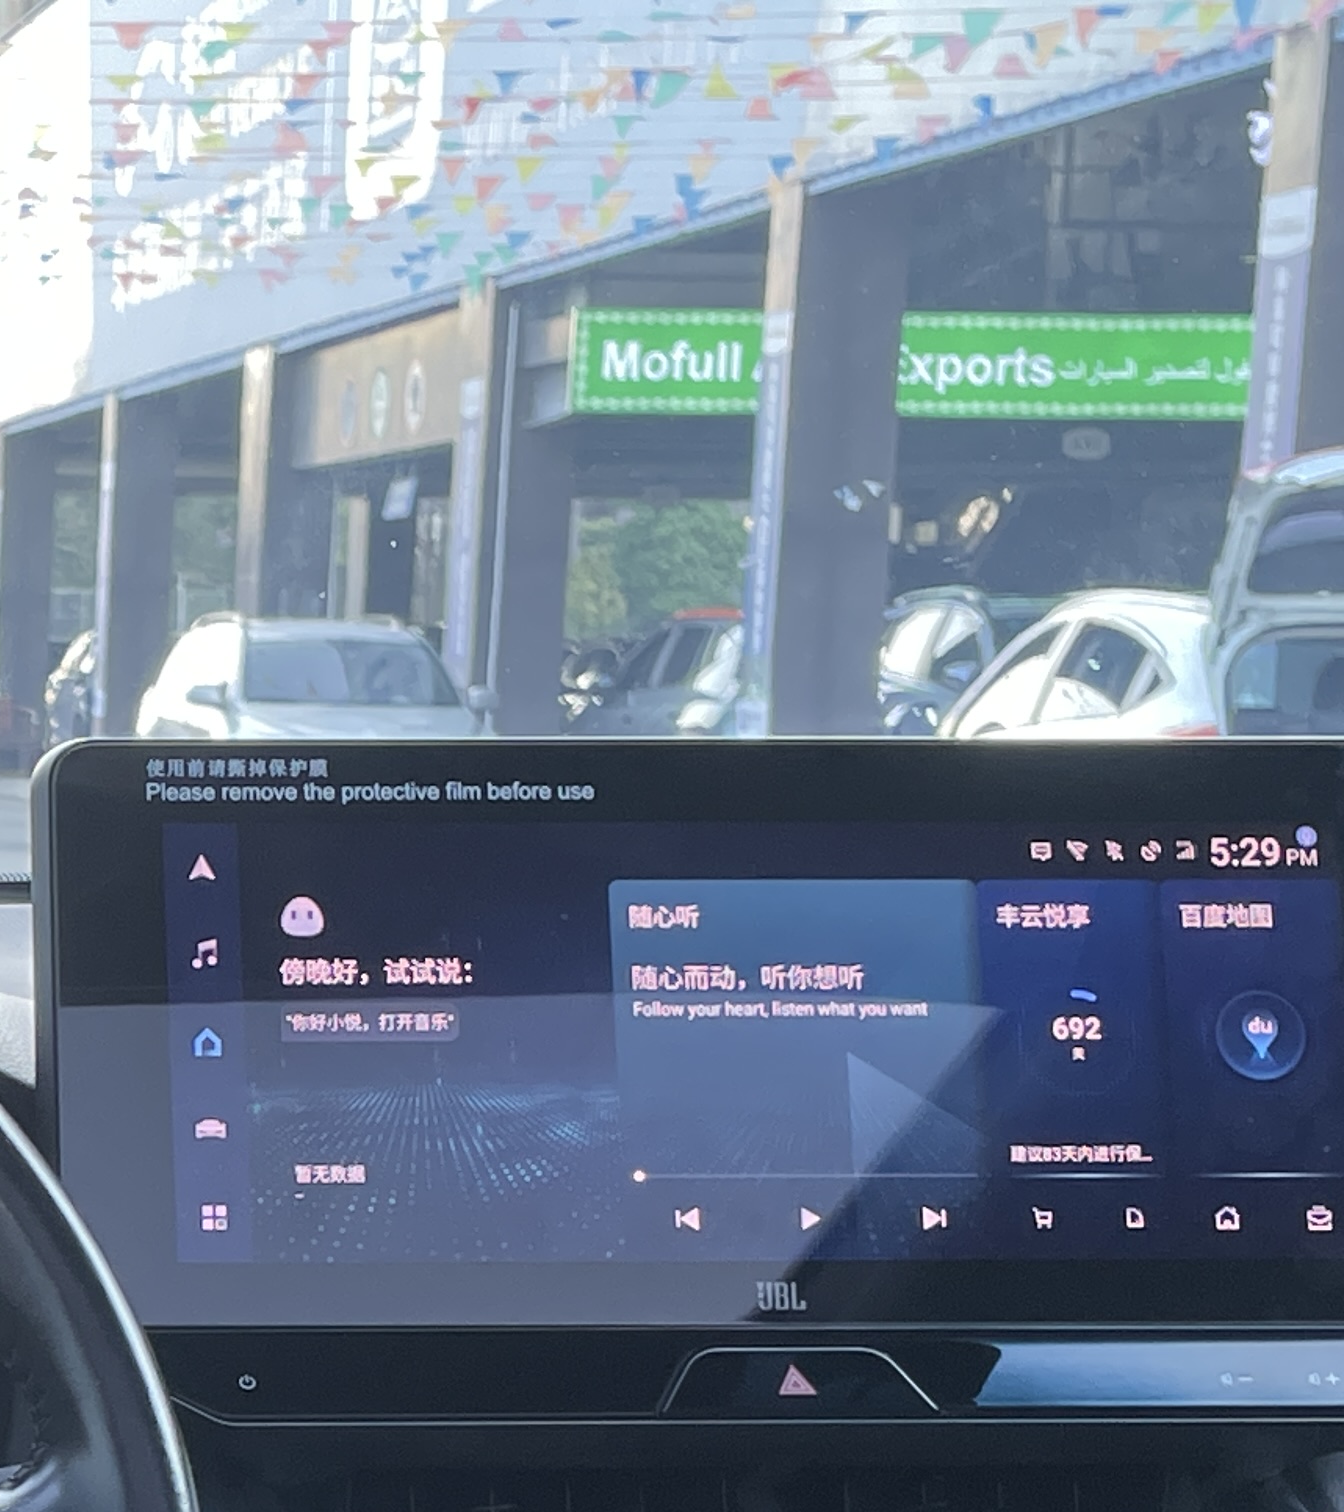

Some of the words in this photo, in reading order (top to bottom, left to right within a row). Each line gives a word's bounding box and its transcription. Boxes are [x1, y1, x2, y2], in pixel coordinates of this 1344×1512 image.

[601, 338, 744, 383] Mofull
[146, 758, 329, 779] 使用前请撕掉保护膜
[146, 782, 216, 801] Please
[221, 784, 297, 801] remove
[302, 782, 336, 801] the
[341, 782, 440, 805] protective
[445, 781, 481, 800] film
[487, 781, 551, 801] before
[557, 784, 595, 801] use
[1210, 836, 1281, 867] 5:29
[1285, 848, 1319, 867] PM
[627, 904, 700, 929] 随心听
[996, 903, 1091, 929] 丰云悦享
[1178, 903, 1274, 929] 百度地图
[630, 964, 864, 992] 随心而动，听你想听
[632, 1001, 685, 1017] Follow
[687, 1003, 721, 1020] your
[724, 1001, 769, 1018] heart,
[771, 1000, 815, 1017] listen
[818, 1001, 855, 1017] what
[857, 1004, 888, 1020] you
[891, 1002, 928, 1017] want
[1051, 1016, 1102, 1040] 692
[1247, 1016, 1273, 1034] du
[294, 1164, 367, 1184] 暂无数据
[755, 1281, 807, 1312] JBL
